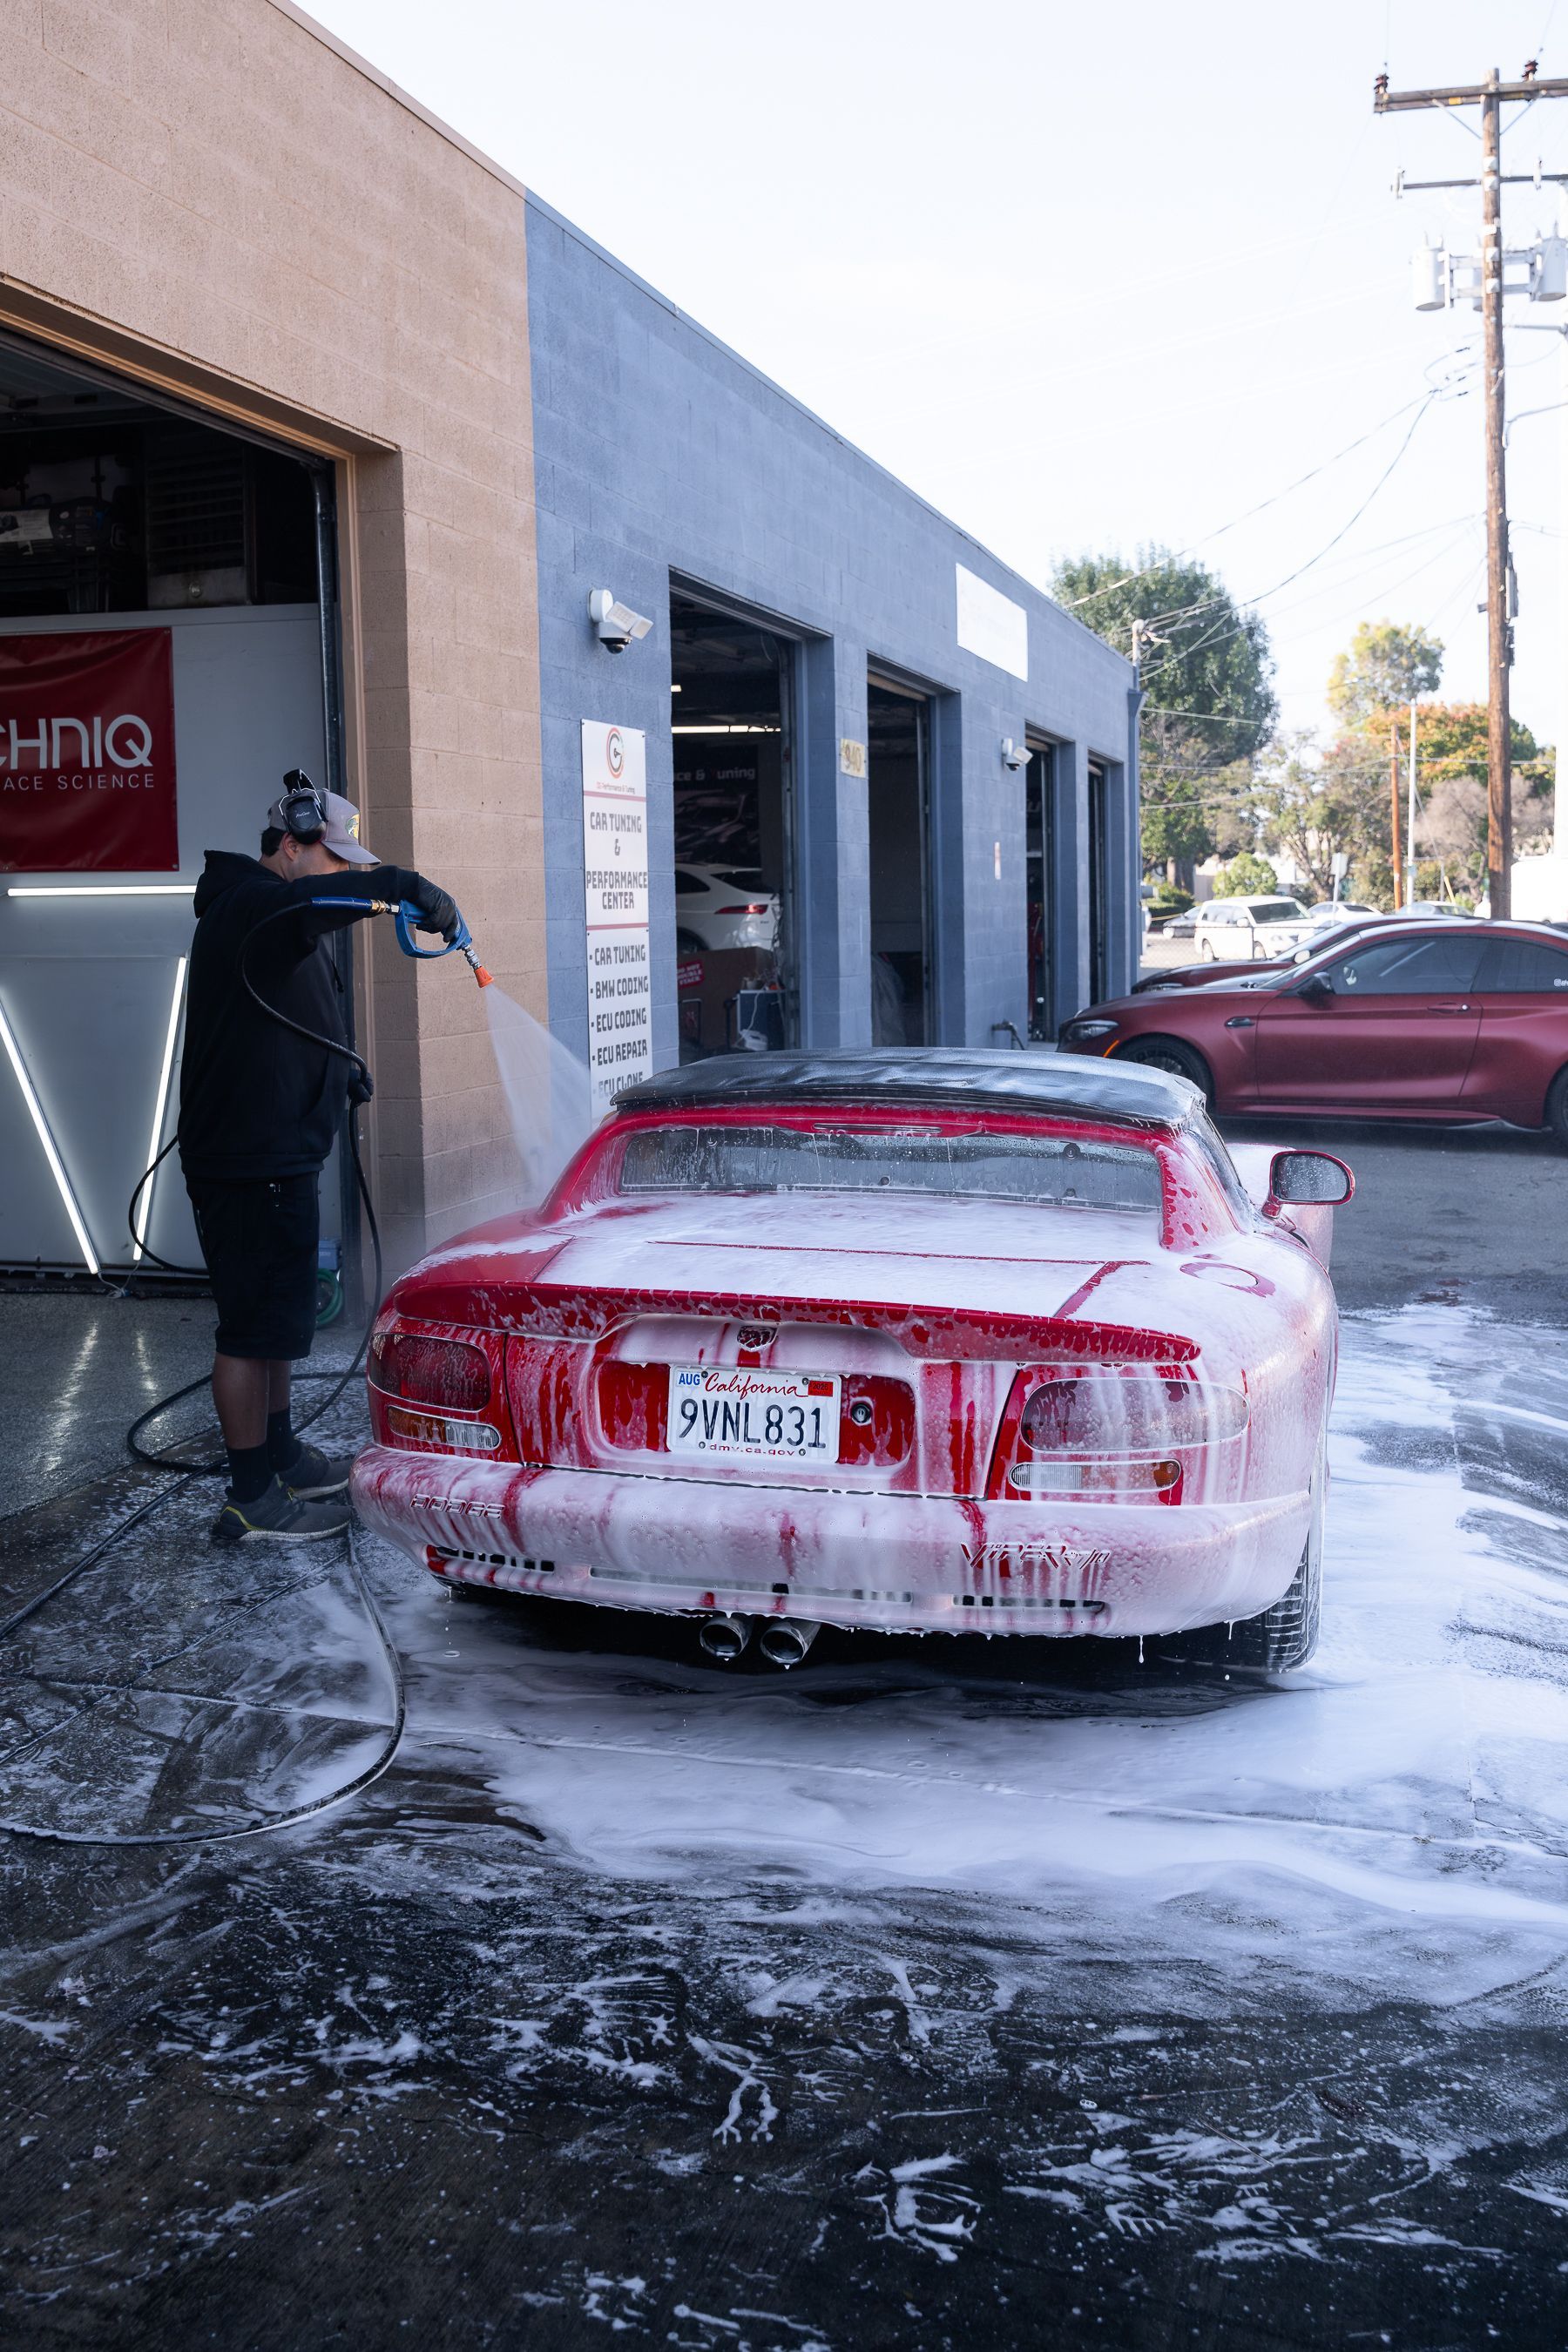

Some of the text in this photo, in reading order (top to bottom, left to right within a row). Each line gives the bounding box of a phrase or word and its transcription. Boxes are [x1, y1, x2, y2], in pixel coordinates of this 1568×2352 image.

[0, 715, 153, 770] HNIQ
[3, 774, 154, 791] ACE SCIENCE
[590, 812, 642, 833] CAR TUNING
[614, 839, 621, 856] &
[585, 870, 648, 889] PERFORMANCE
[602, 891, 635, 910] CENTER
[594, 944, 646, 966] CAR TUNING
[595, 976, 649, 999] BMW CODING
[596, 1008, 647, 1032] ECU CODING
[597, 1039, 648, 1066] ECU REPAIR
[679, 1372, 808, 1400] AUG California
[679, 1398, 827, 1450] 9VNL831
[709, 1443, 795, 1456] dmv.ca.gov
[410, 1493, 505, 1519] DODGE
[961, 1542, 1067, 1569] VIPER
